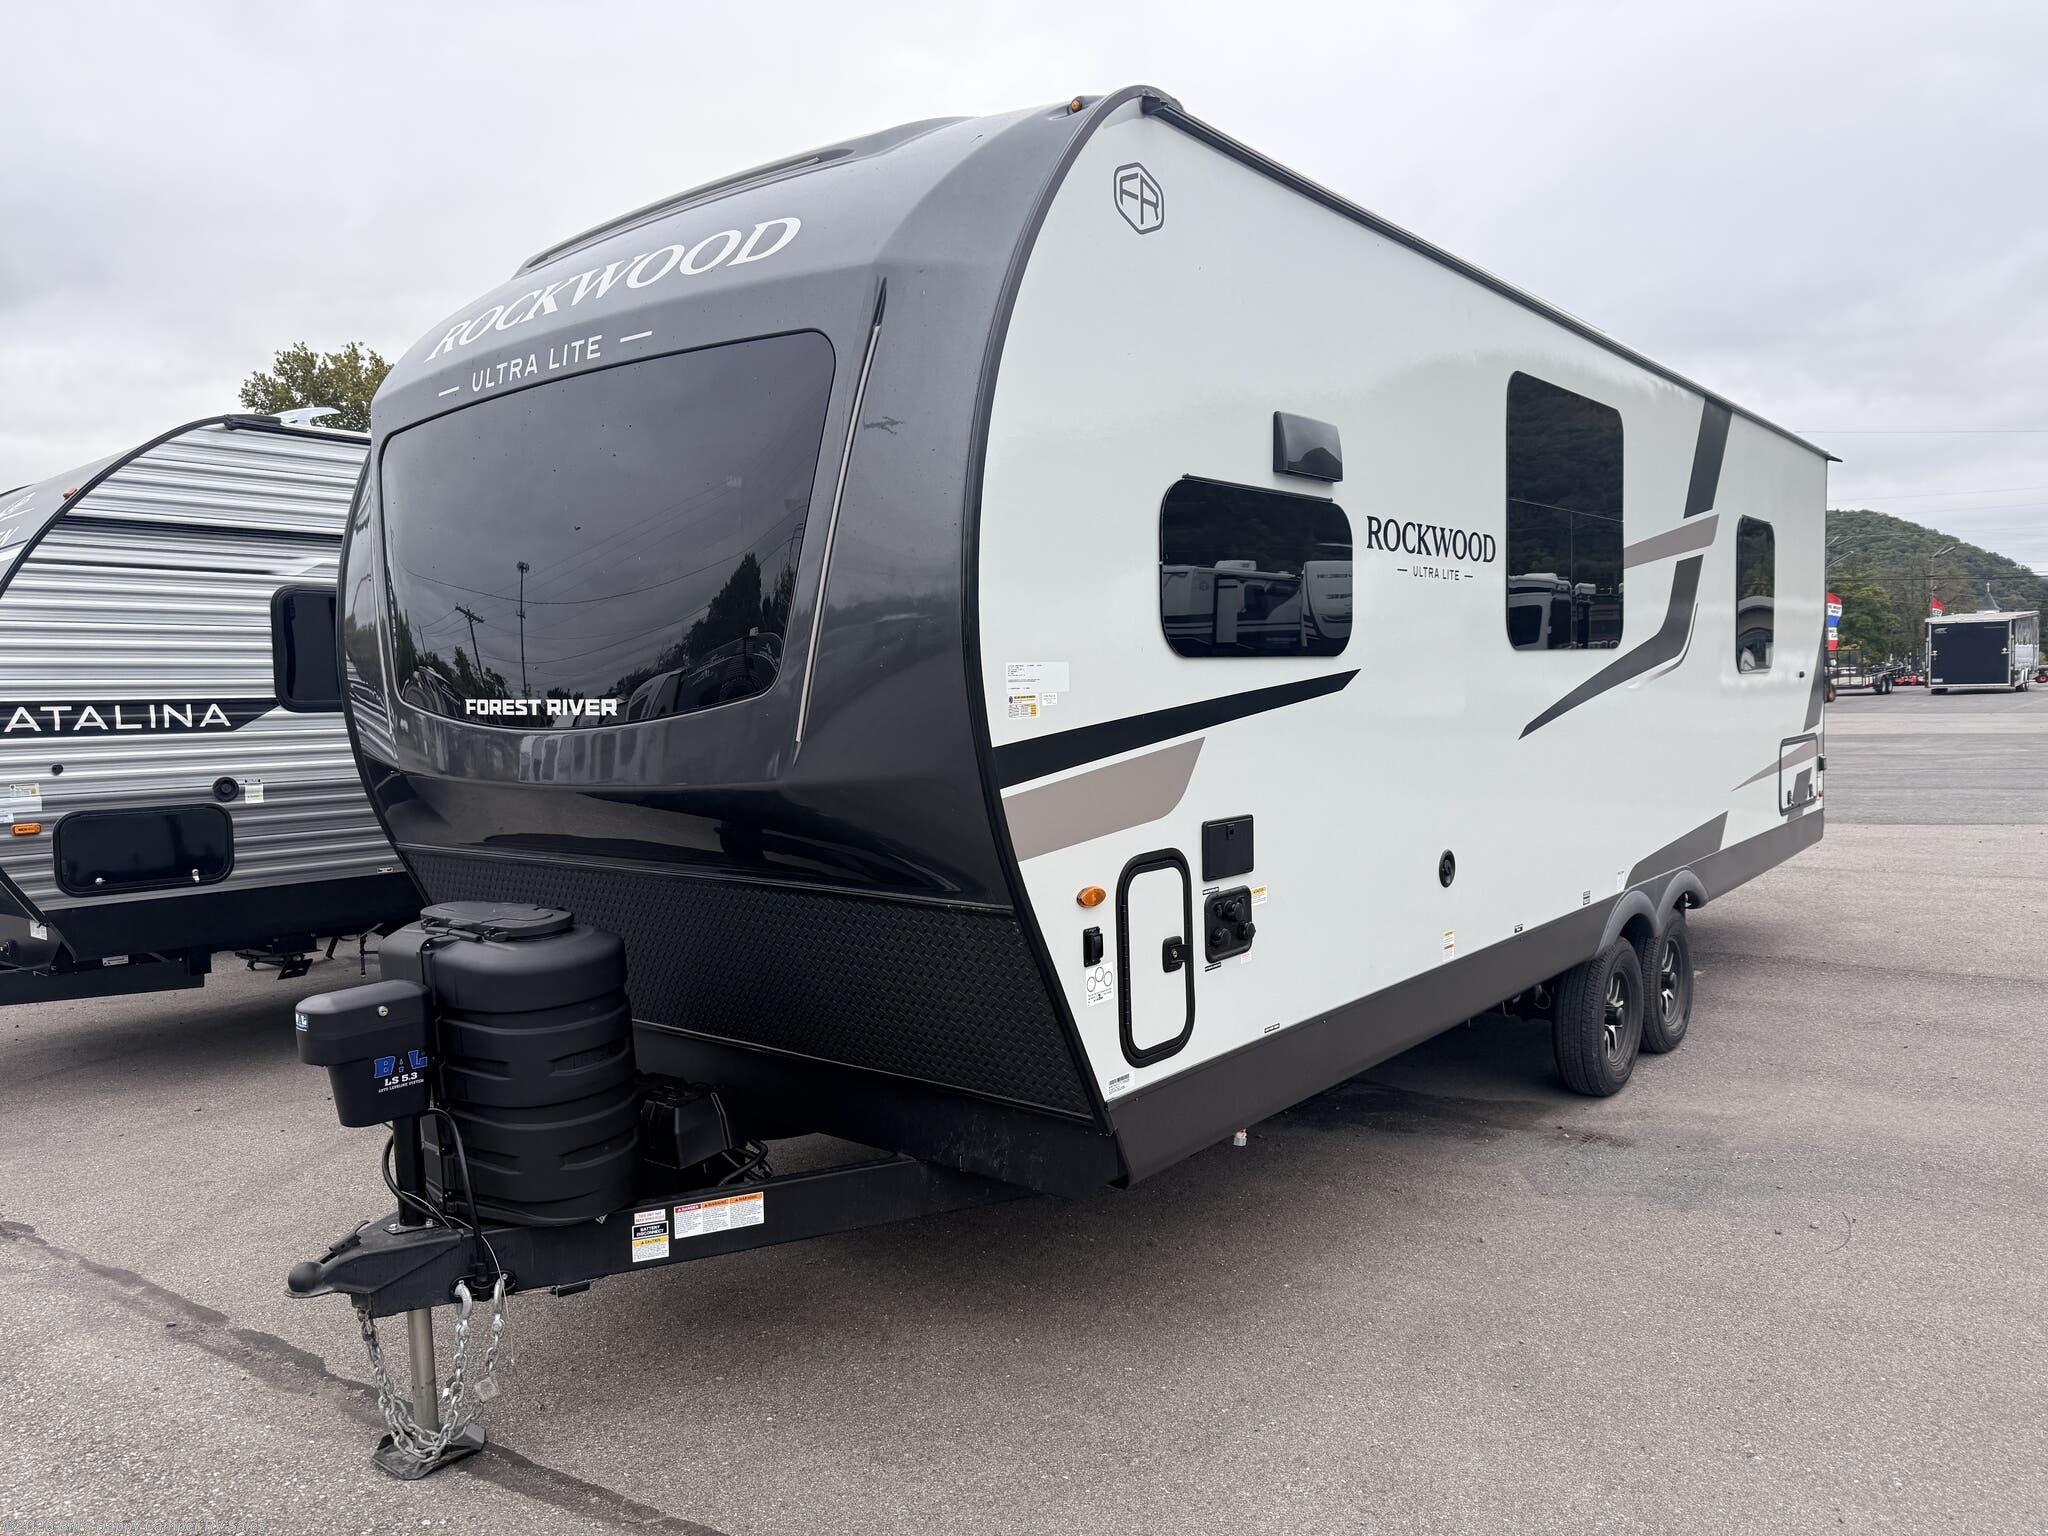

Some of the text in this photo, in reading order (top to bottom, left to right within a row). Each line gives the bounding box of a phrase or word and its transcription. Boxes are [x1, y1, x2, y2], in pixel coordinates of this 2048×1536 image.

[424, 216, 802, 364] ROCKWOOD
[471, 334, 603, 393] ULTRA LITE
[1366, 515, 1496, 563] ROCKWOOD
[1412, 565, 1460, 581] ULTRA LITE
[464, 698, 618, 717] FOREST RIVER
[384, 1072, 418, 1087] LS 5.3
